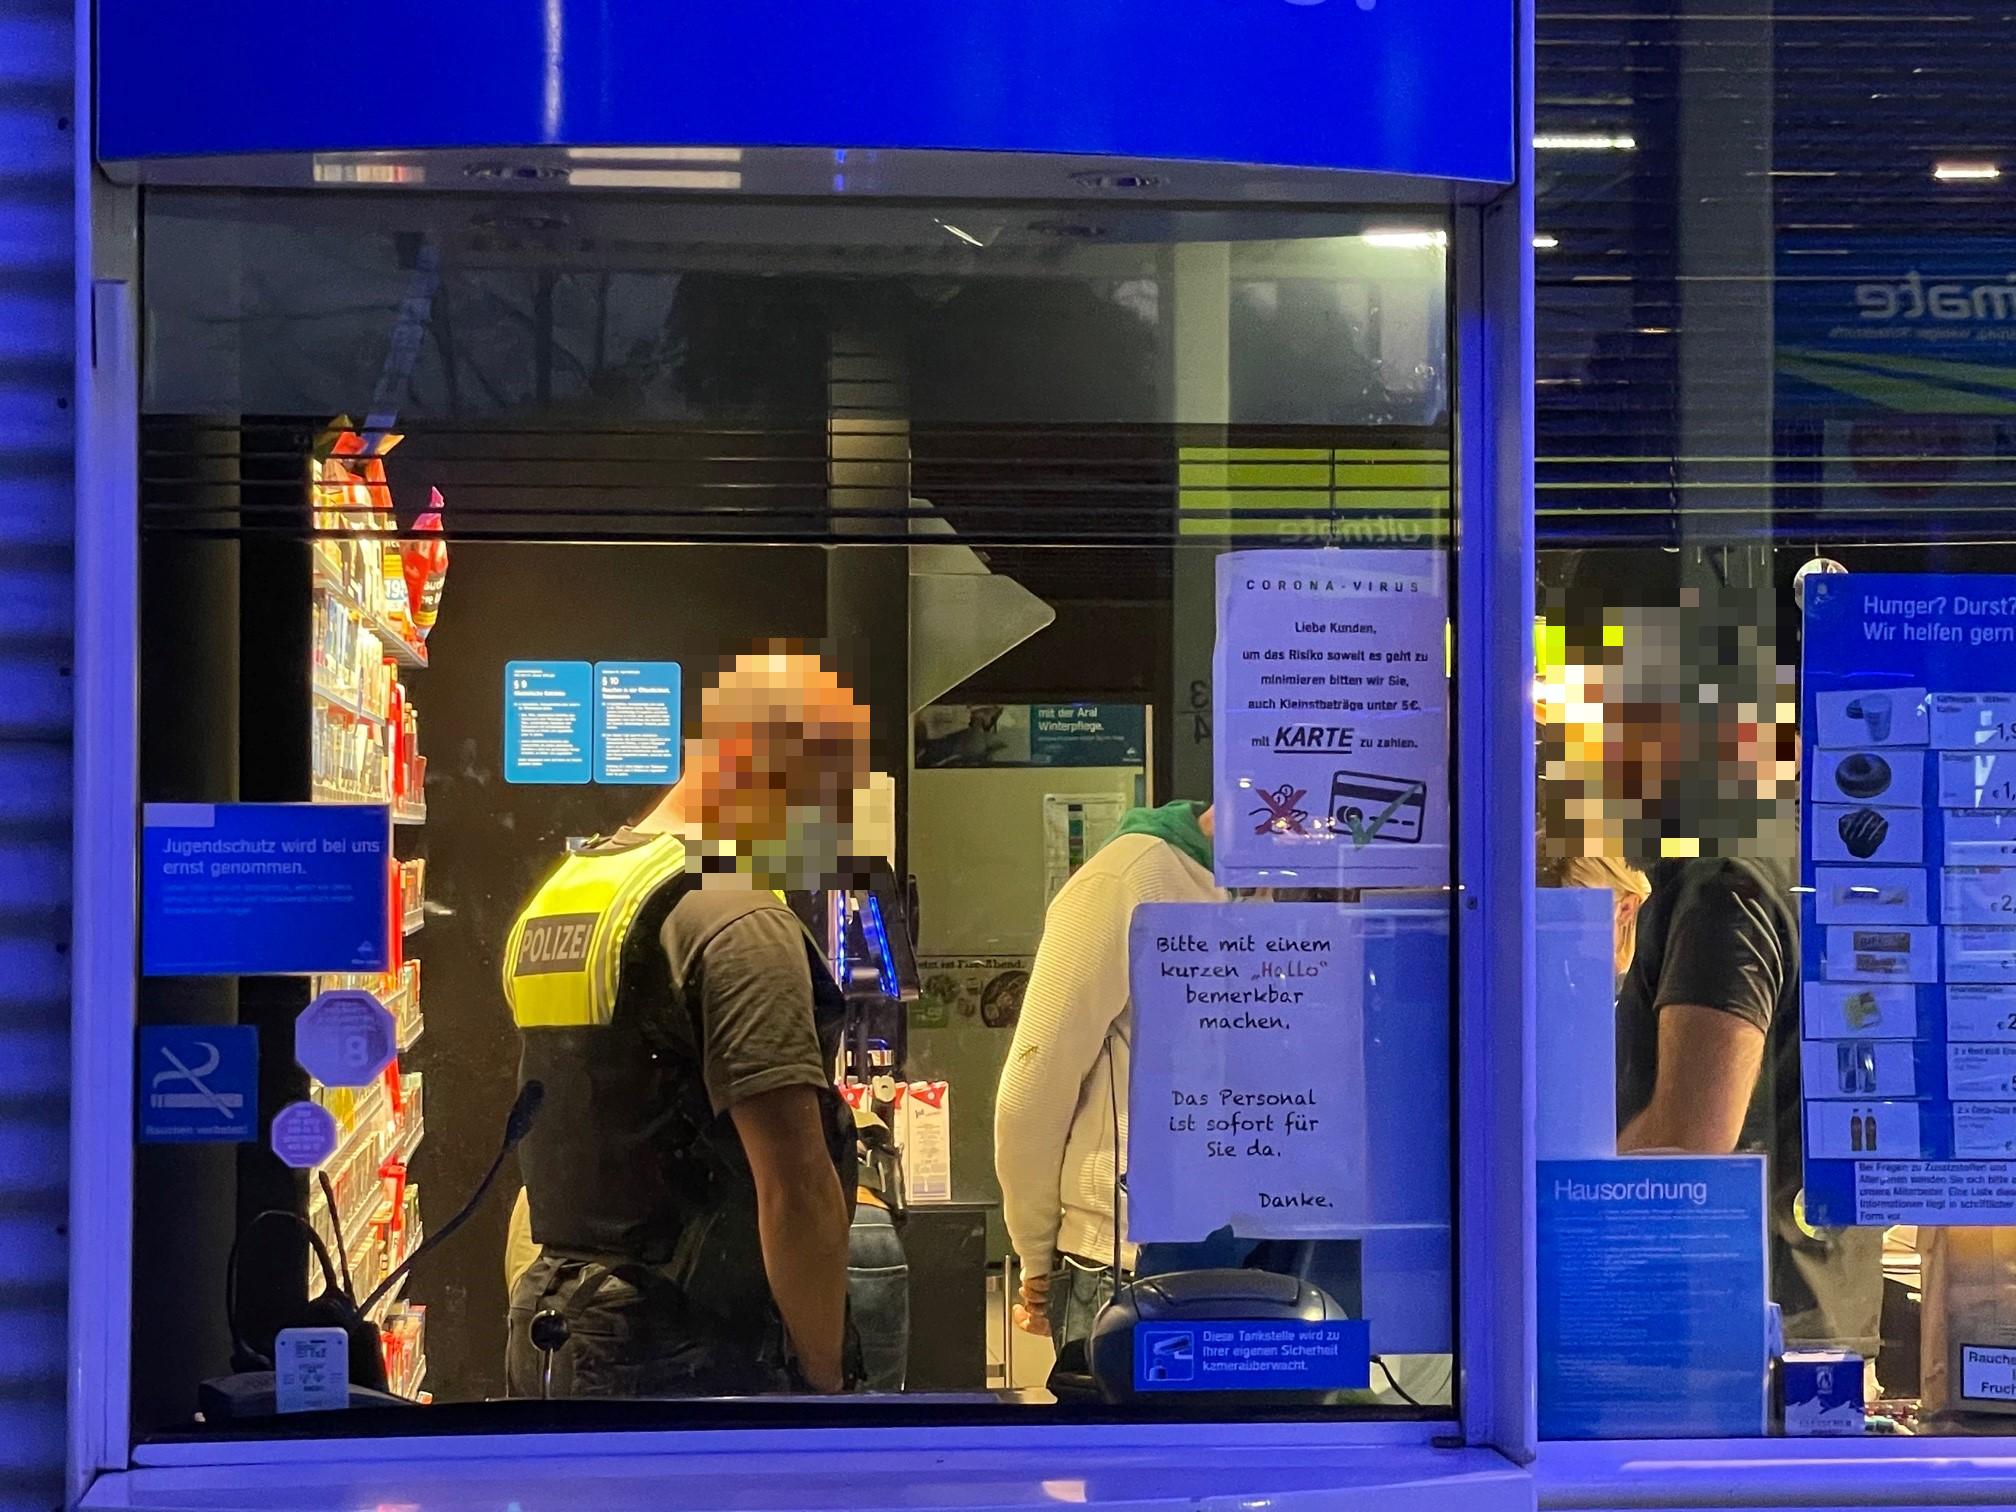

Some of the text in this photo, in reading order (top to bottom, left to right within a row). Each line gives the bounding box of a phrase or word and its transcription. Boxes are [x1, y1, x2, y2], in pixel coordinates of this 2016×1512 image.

[1863, 595, 2016, 618] Hunger? Durst?
[1295, 621, 1377, 635] Liebe Kunden,
[1863, 621, 2014, 645] Wir helfen gern
[1242, 649, 1429, 663] um das Risiko soweit es geht zu
[1260, 675, 1326, 685] minimieren
[1329, 675, 1362, 686] bitten
[1366, 676, 1384, 686] wir
[1038, 707, 1098, 718] mit der Aral
[1248, 699, 1276, 709] auch
[1280, 698, 1364, 712] Kleinstbeträge
[1367, 699, 1397, 711] unter
[1038, 720, 1104, 733] Winterpflege.
[1251, 726, 1418, 749] mit KARTE zu zahlen.
[163, 838, 381, 856] Jugendschutz wird bei uns
[163, 861, 307, 878] ernst genommen.
[519, 924, 593, 964] POLIZEI
[1157, 935, 1331, 952] Bitte mit einem
[917, 960, 938, 969] etzt
[1161, 962, 1239, 978] kurzen
[1186, 983, 1304, 1004] bemerkbar
[1199, 1012, 1290, 1029] machen.
[1171, 1089, 1317, 1106] Das Personal
[145, 1125, 193, 1136] Rauchen
[1169, 1111, 1319, 1137] ist sofort für
[1207, 1139, 1281, 1157] Sie da.
[1876, 1163, 1909, 1174] Fragen
[1911, 1164, 1922, 1172] zu
[1554, 1178, 1708, 1205] Hausordnung
[1258, 1192, 1334, 1208] Danke.
[1859, 1211, 1885, 1221] Form
[1203, 1330, 1340, 1342] Diese Tankstelle wird zu
[1203, 1344, 1339, 1359] Ihrer eigenen Sicherheit
[1202, 1359, 1309, 1372] kameraüberwacht.
